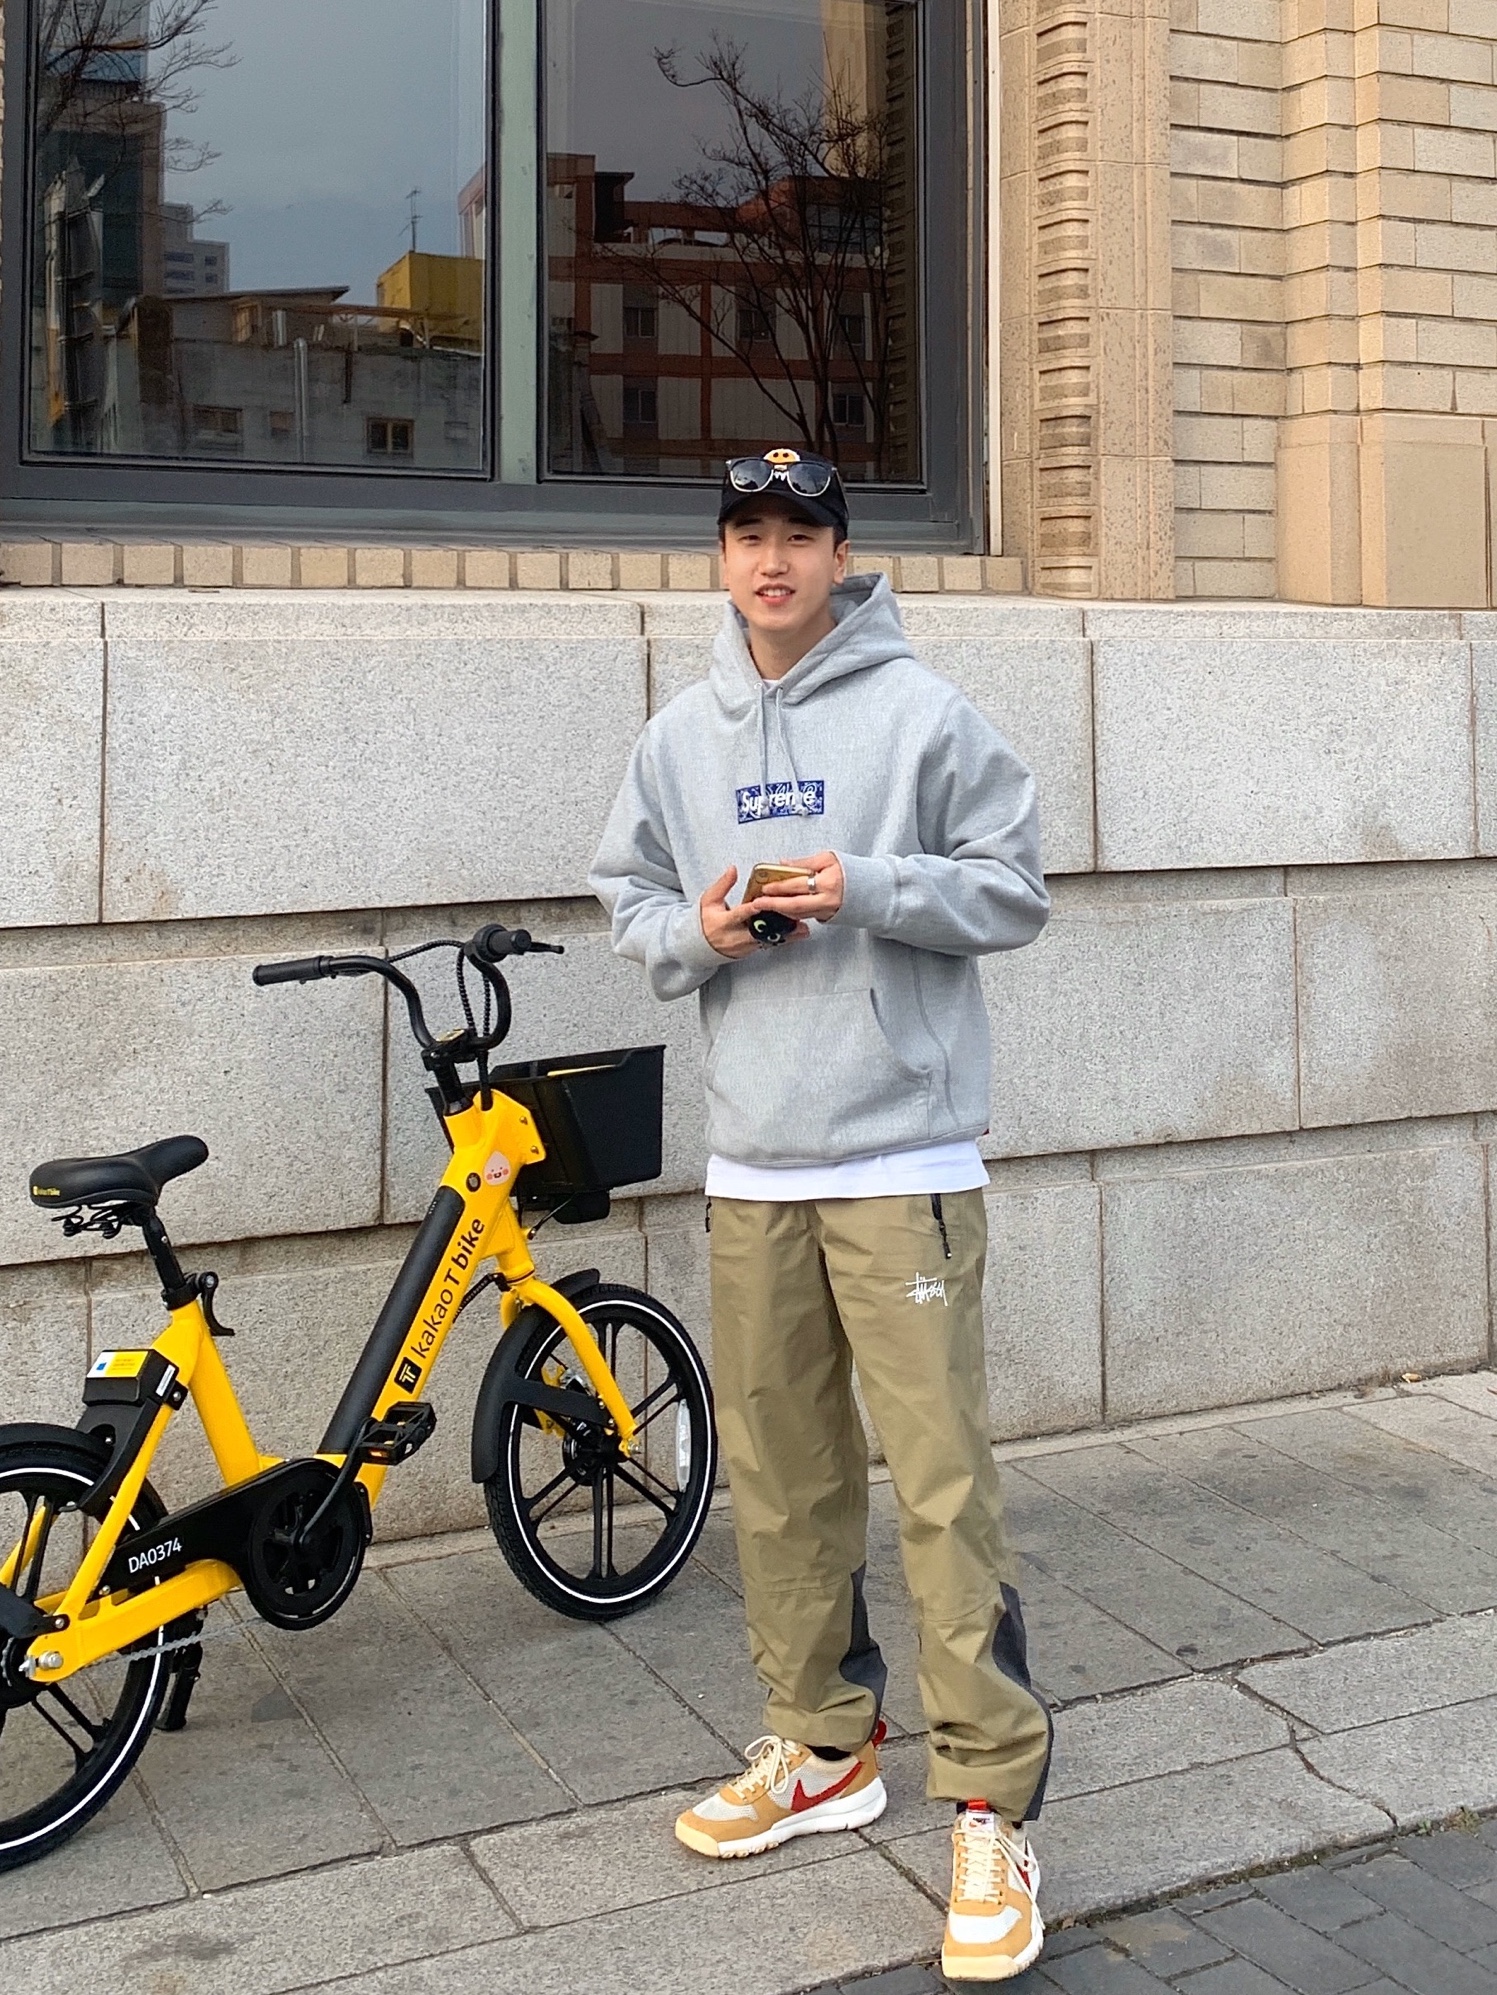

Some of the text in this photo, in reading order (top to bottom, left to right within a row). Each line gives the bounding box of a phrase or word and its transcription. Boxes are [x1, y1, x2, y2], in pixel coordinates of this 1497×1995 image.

[451, 1218, 485, 1271] bike
[444, 1268, 461, 1286] T
[410, 1288, 454, 1359] kakao
[128, 1537, 182, 1574] DA0374
